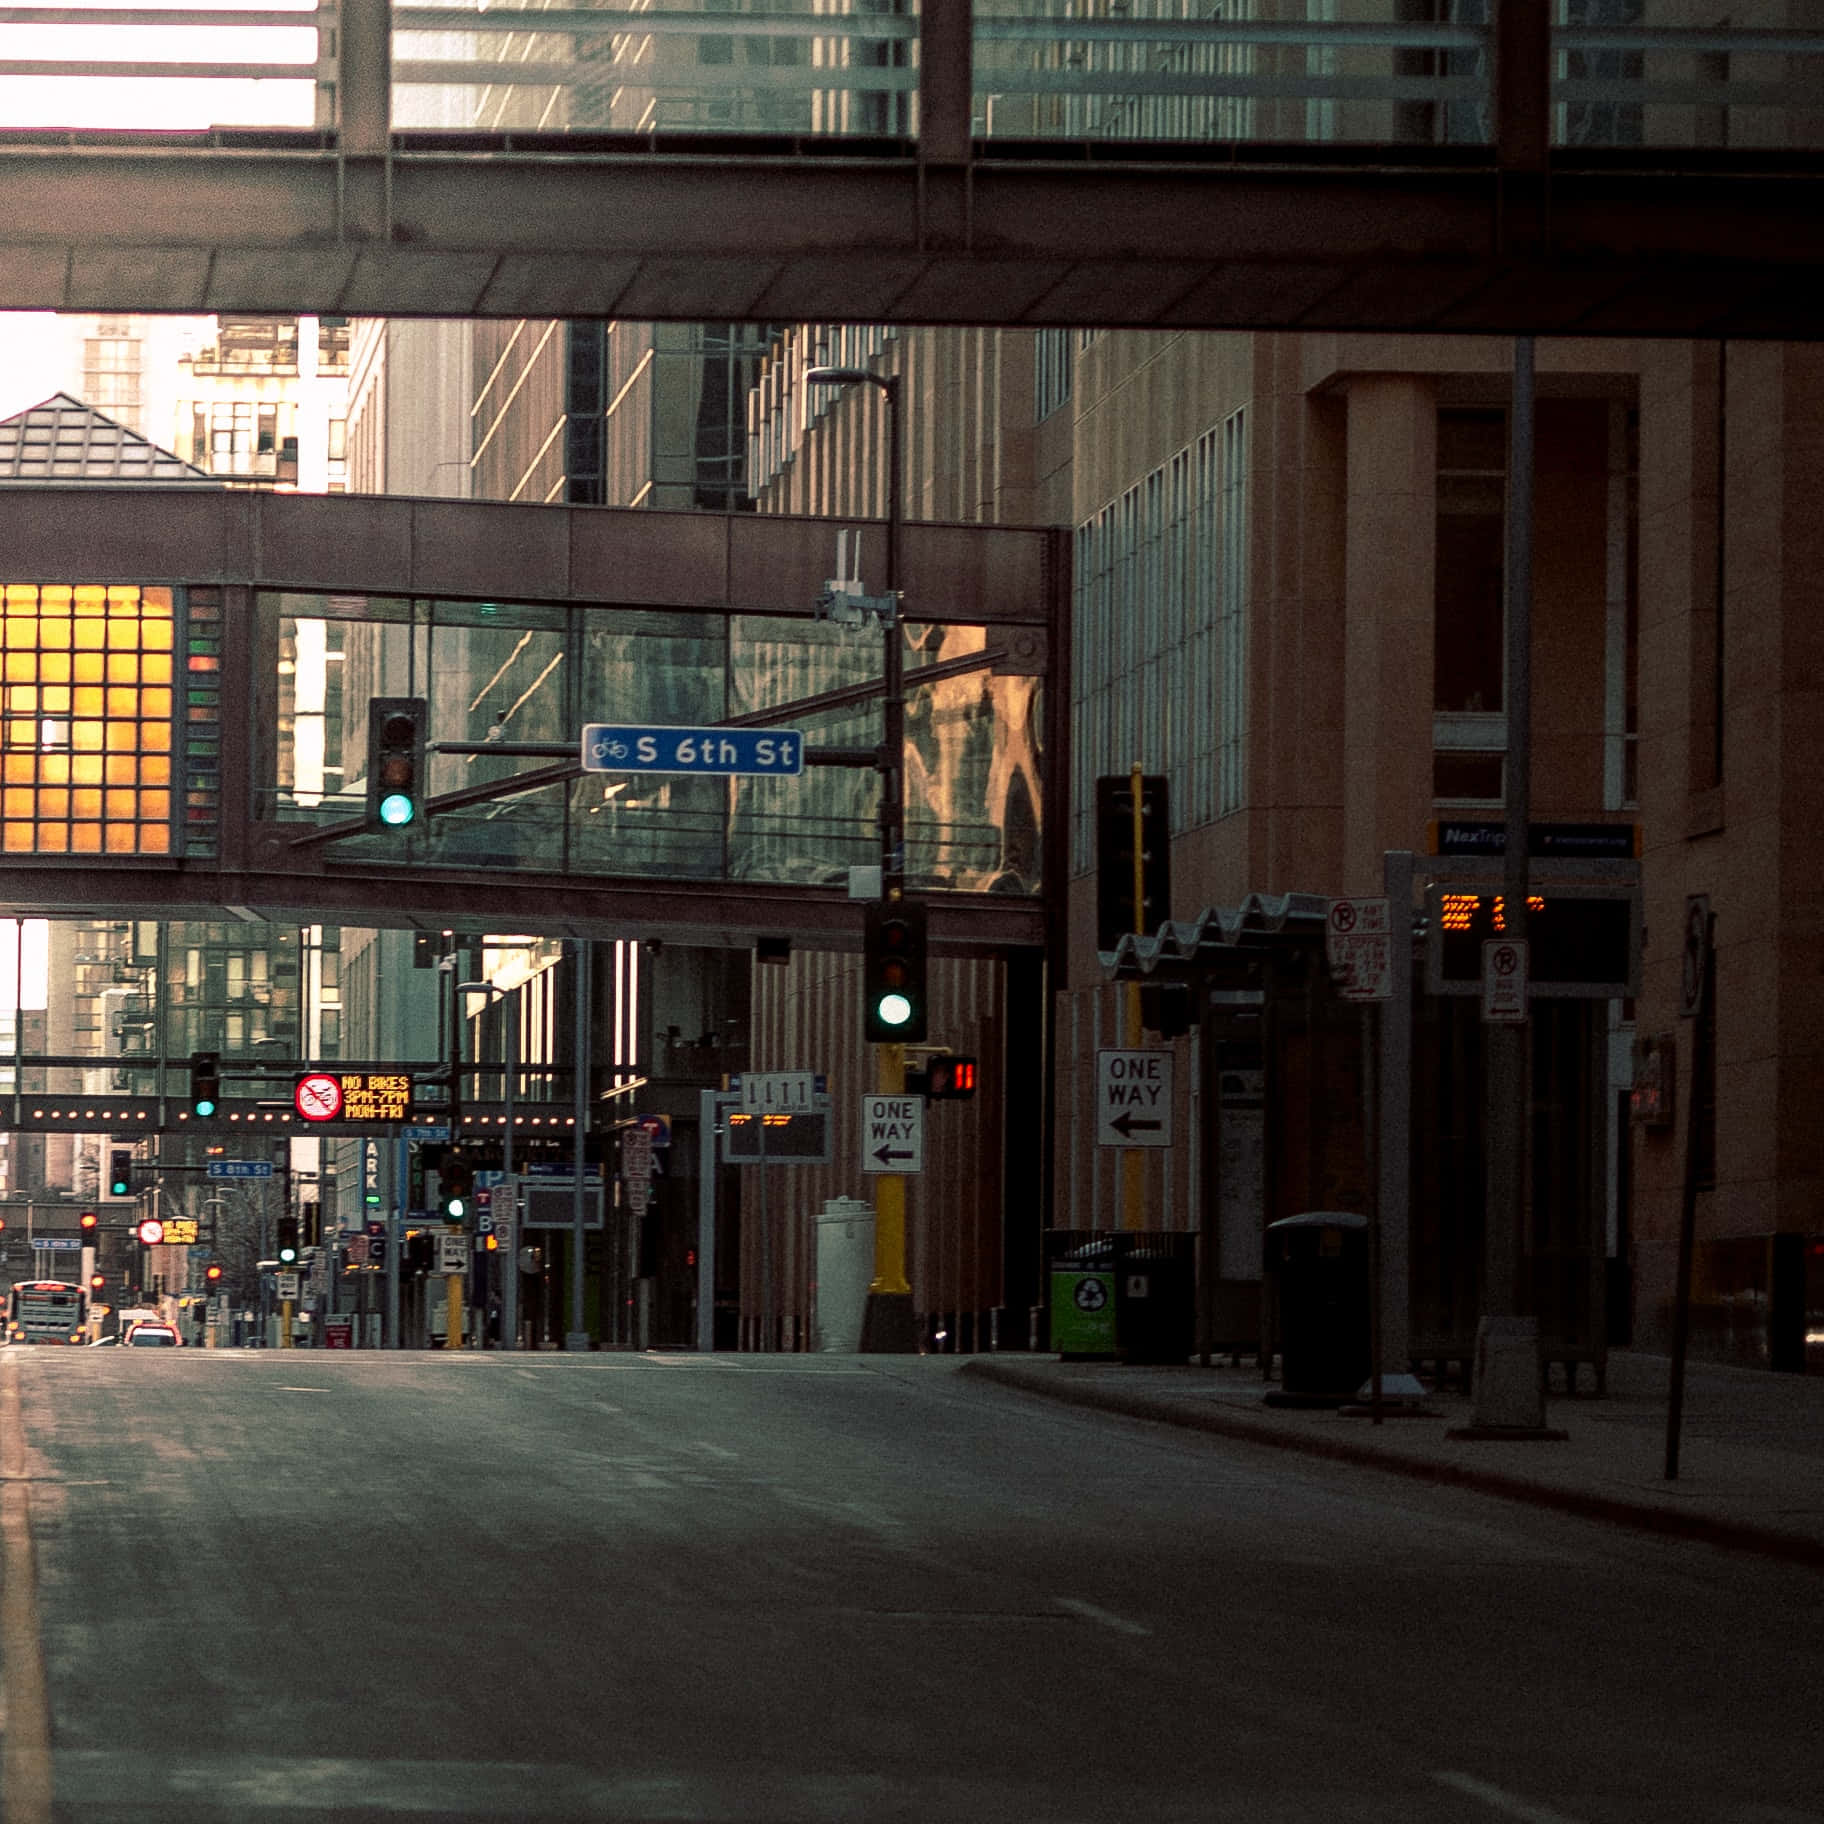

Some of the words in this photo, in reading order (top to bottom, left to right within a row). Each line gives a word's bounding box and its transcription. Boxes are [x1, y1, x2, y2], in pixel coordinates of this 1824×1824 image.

[636, 735, 658, 763] S
[675, 737, 738, 764] 6th
[755, 739, 794, 766] St
[1110, 1058, 1161, 1080] ONE
[341, 1076, 362, 1090] NO
[368, 1076, 409, 1090] BIKES
[343, 1090, 409, 1104] 3PM-7PM
[1108, 1084, 1162, 1105] WAY
[345, 1104, 403, 1118] MON-FRI
[872, 1102, 913, 1120] ONE
[871, 1122, 914, 1140] WAY
[213, 1164, 221, 1174] S
[366, 1137, 378, 1189] ARK
[479, 1216, 493, 1232] B
[445, 1237, 466, 1246] ONE
